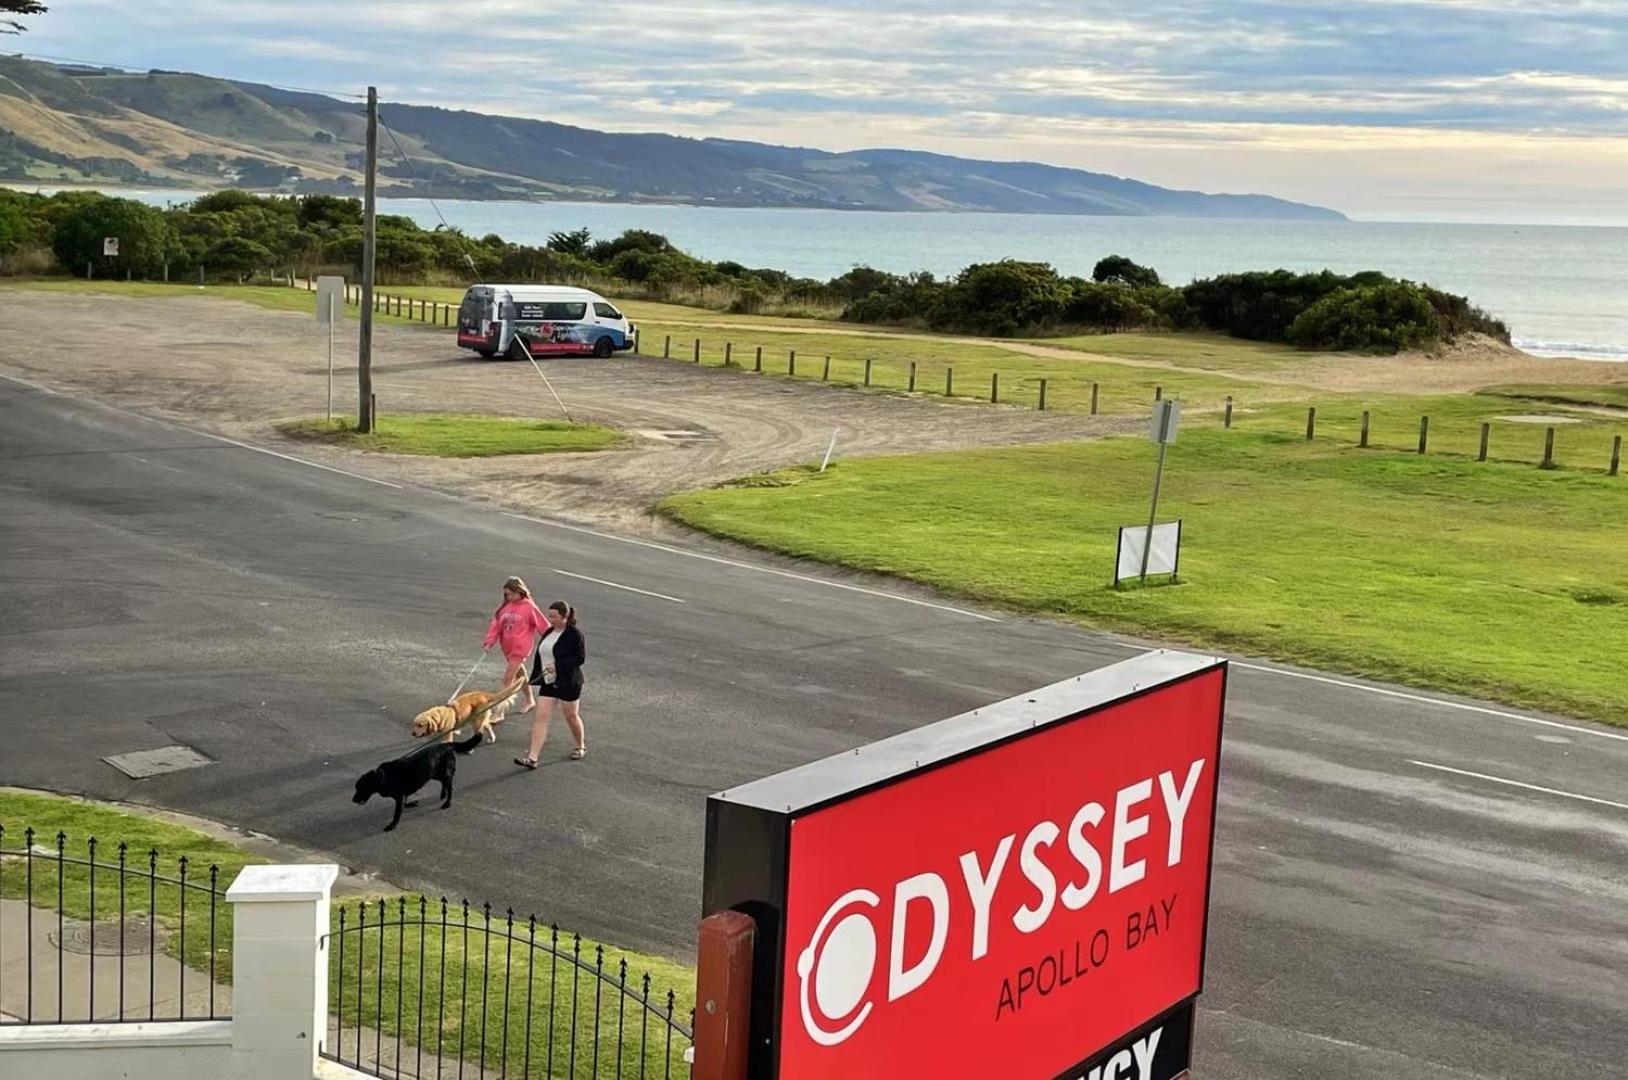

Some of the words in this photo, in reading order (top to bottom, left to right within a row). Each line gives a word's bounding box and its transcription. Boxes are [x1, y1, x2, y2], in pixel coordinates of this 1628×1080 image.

[798, 759, 1205, 1046] ODYSSEY
[996, 928, 1109, 1021] APOLLO
[1126, 894, 1178, 950] BAY
